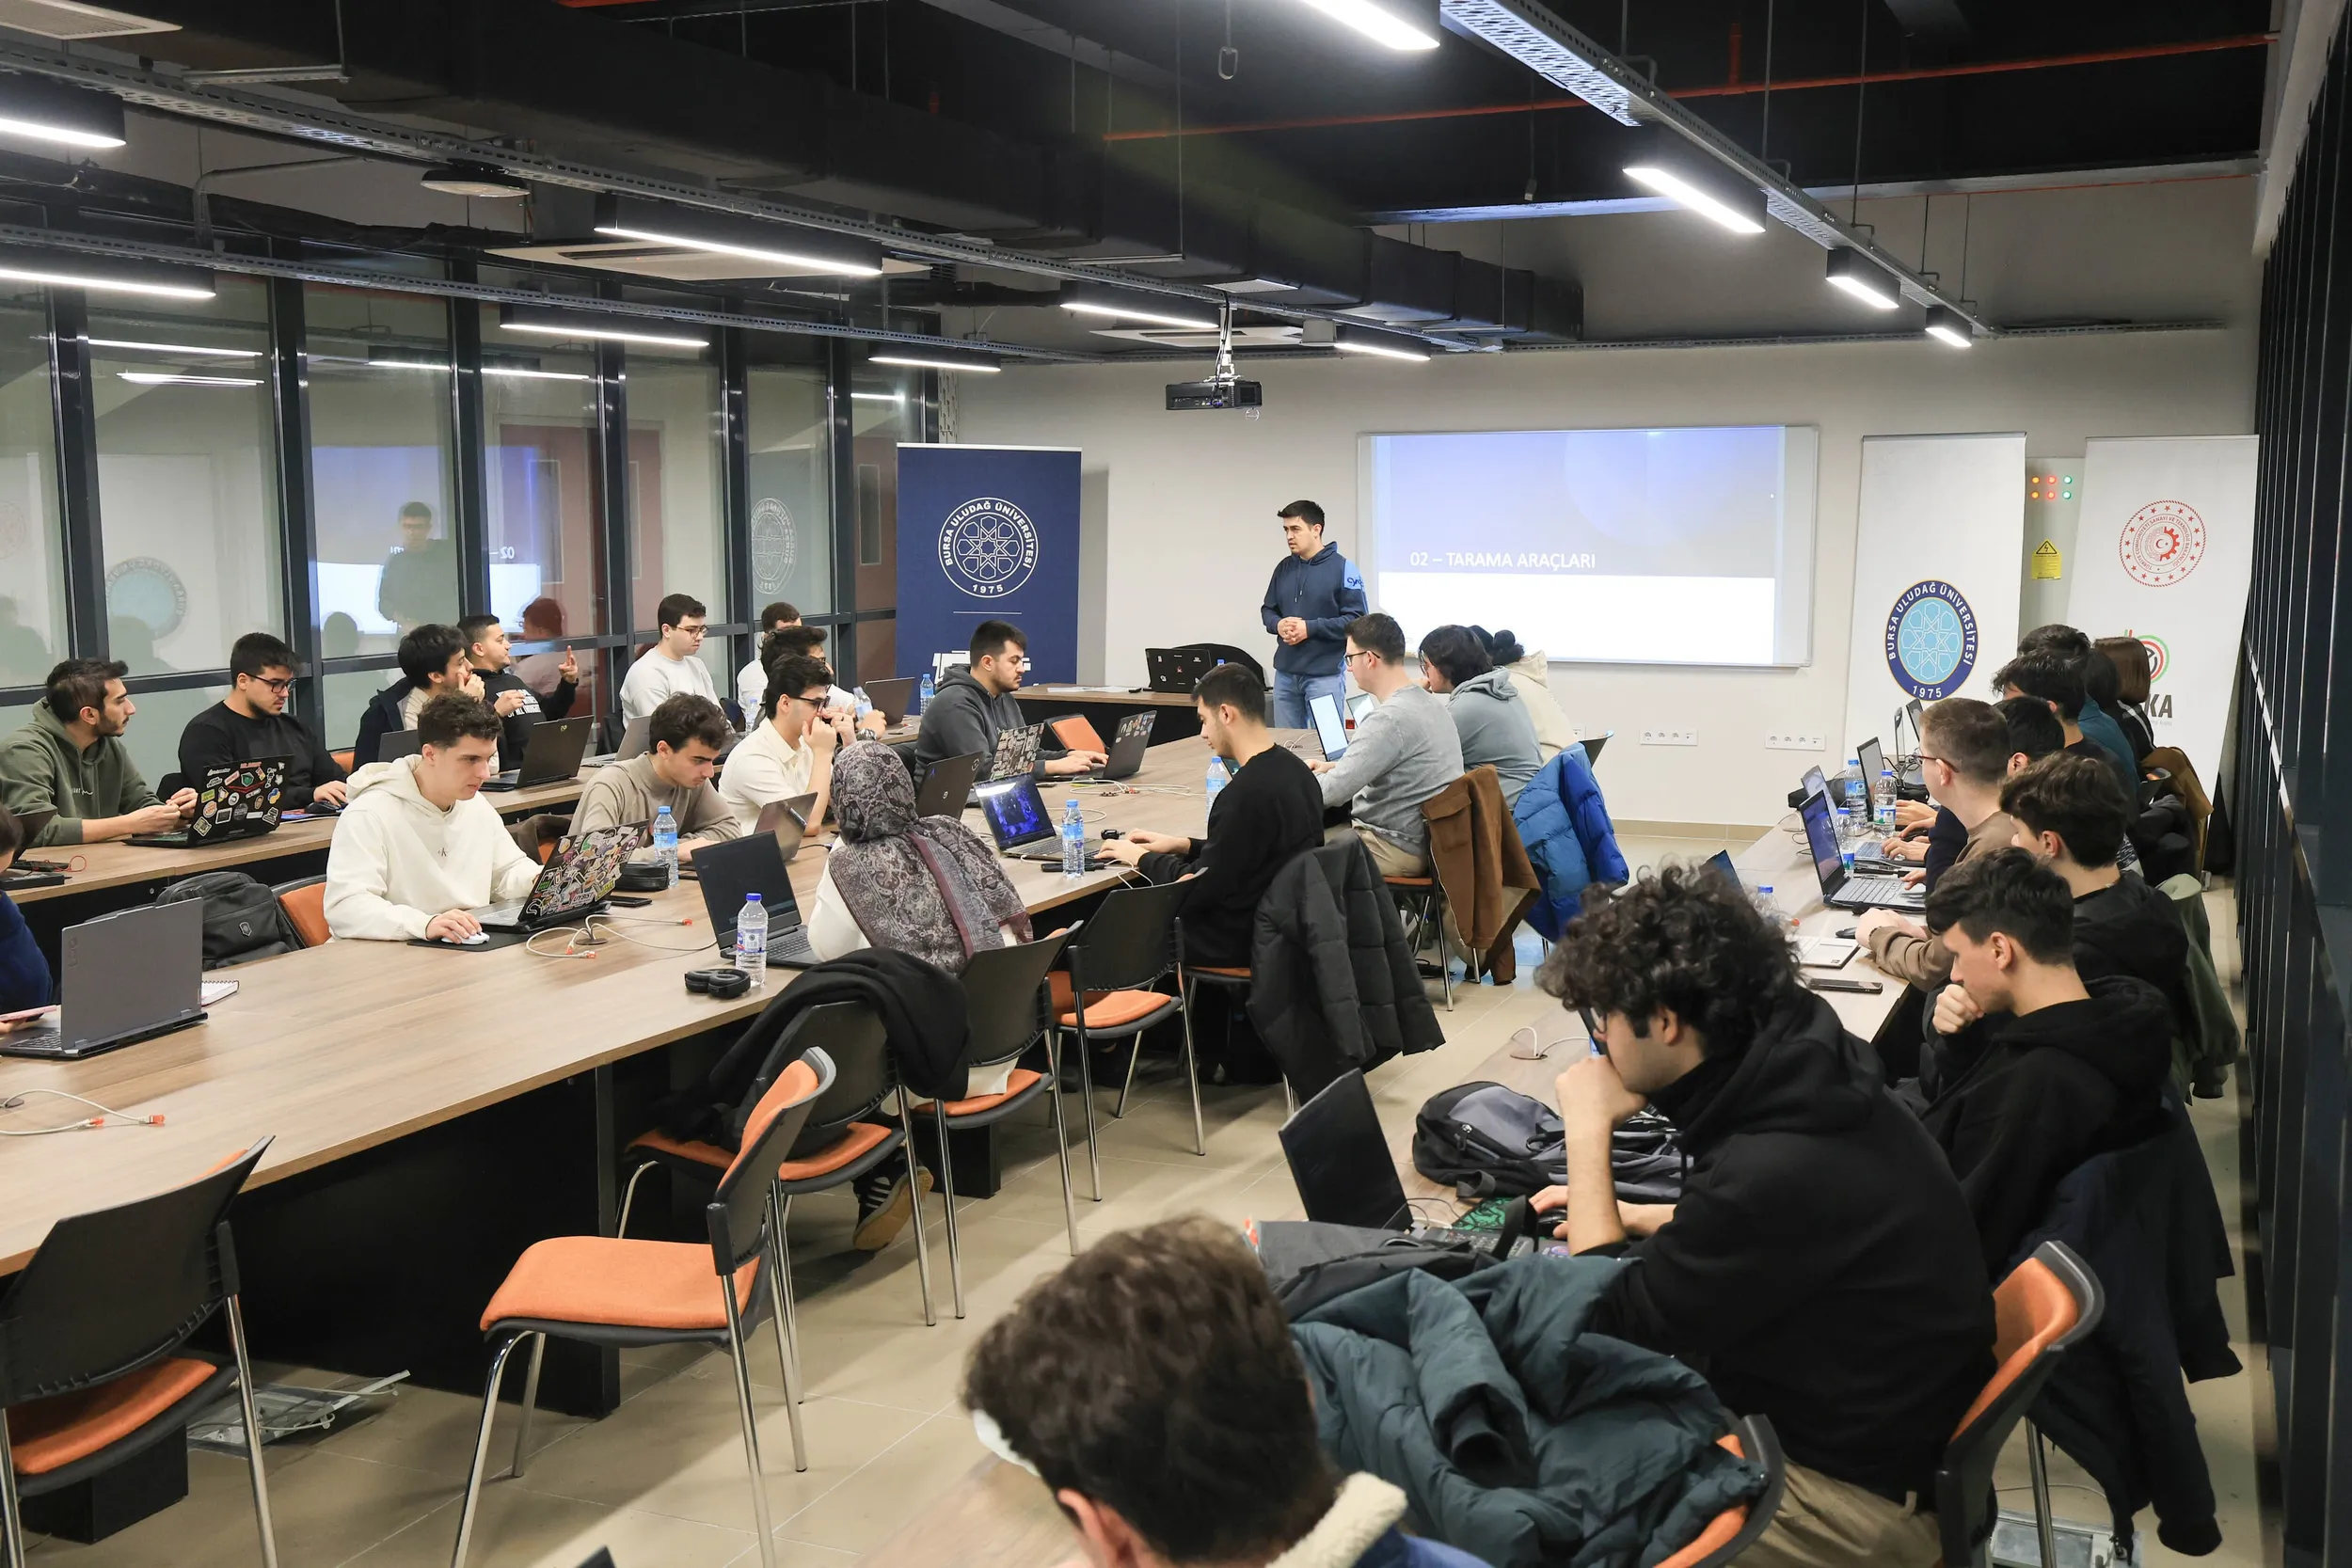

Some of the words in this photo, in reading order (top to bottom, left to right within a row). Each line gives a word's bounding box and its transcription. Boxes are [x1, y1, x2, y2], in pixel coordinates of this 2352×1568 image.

[943, 529, 954, 567] BURSA
[950, 500, 992, 527] ULUDAĞ
[994, 501, 1035, 569] ÜNİVERSİTESİ
[1409, 551, 1429, 566] 02
[1445, 552, 1514, 568] TARAMA
[1517, 552, 1597, 572] ARAÇLARI
[972, 583, 1004, 594] 1975
[1886, 616, 1899, 660] BURSA
[1896, 581, 1936, 613] ULUDAĞ
[1939, 583, 1977, 666] ÜNİVERSİTESİ
[1912, 685, 1942, 699] 1975
[2144, 693, 2173, 719] KA
